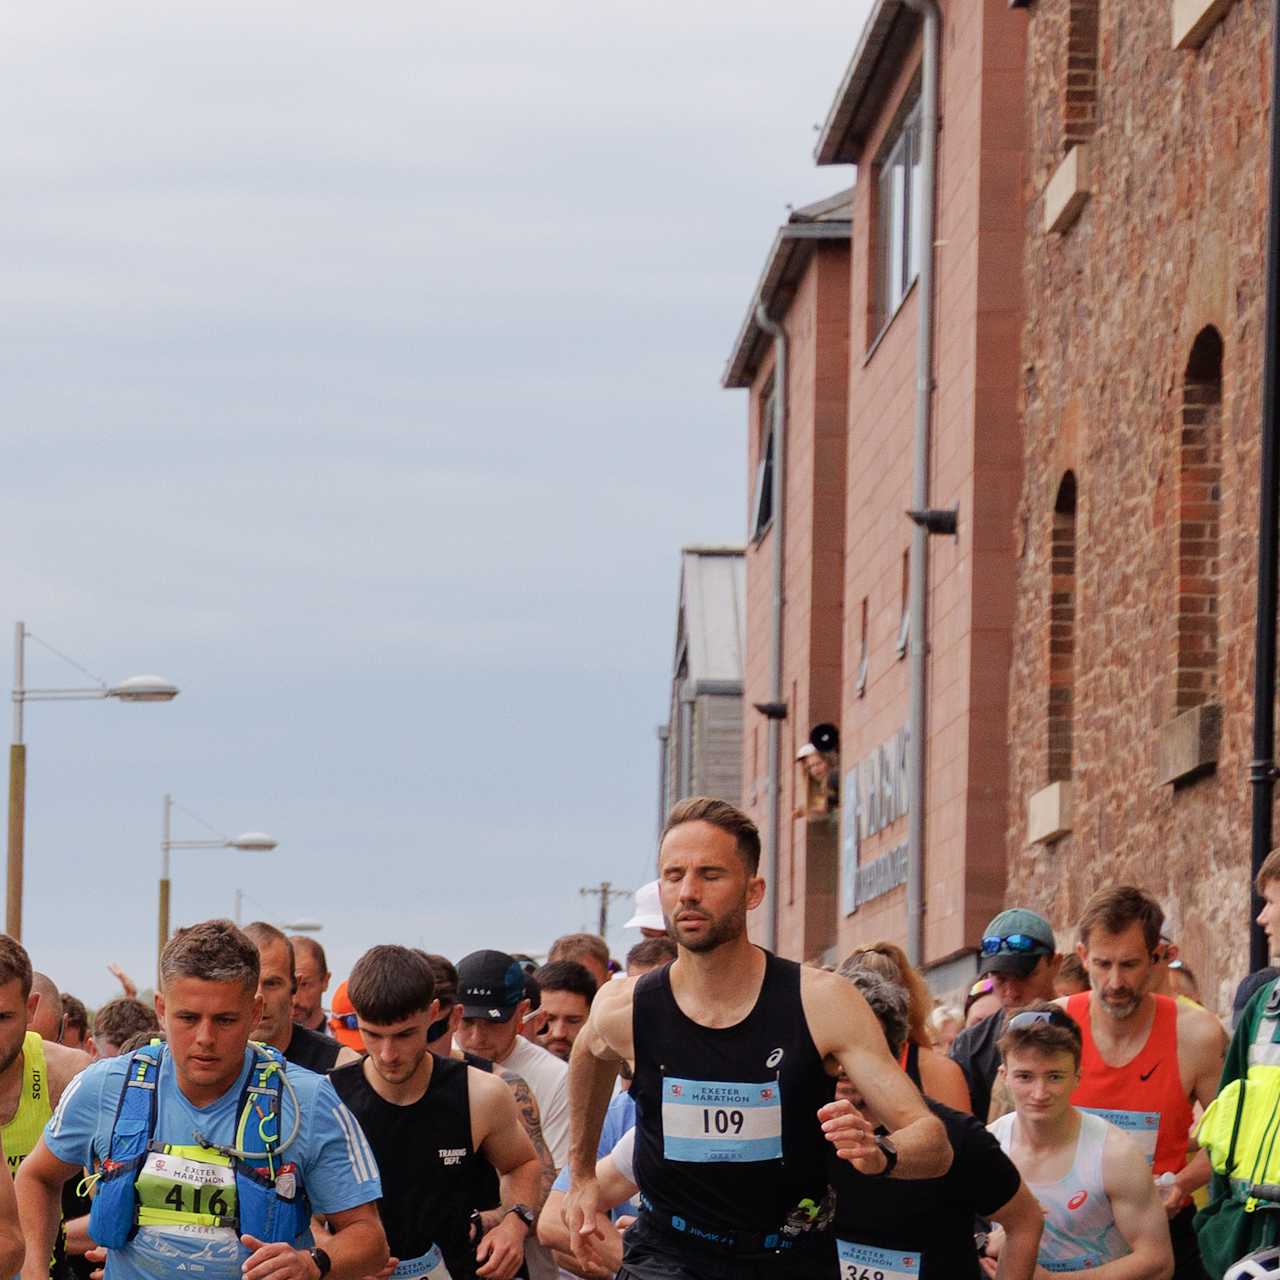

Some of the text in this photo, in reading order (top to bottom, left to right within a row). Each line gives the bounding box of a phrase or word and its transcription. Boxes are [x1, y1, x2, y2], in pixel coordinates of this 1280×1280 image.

[701, 1087, 740, 1095] EXETER
[692, 1094, 750, 1103] MARATHON
[704, 1109, 744, 1134] 109
[184, 1166, 217, 1176] EXETER
[173, 1170, 225, 1184] MARATHON
[165, 1184, 228, 1216] 416
[396, 1261, 424, 1272] XETER
